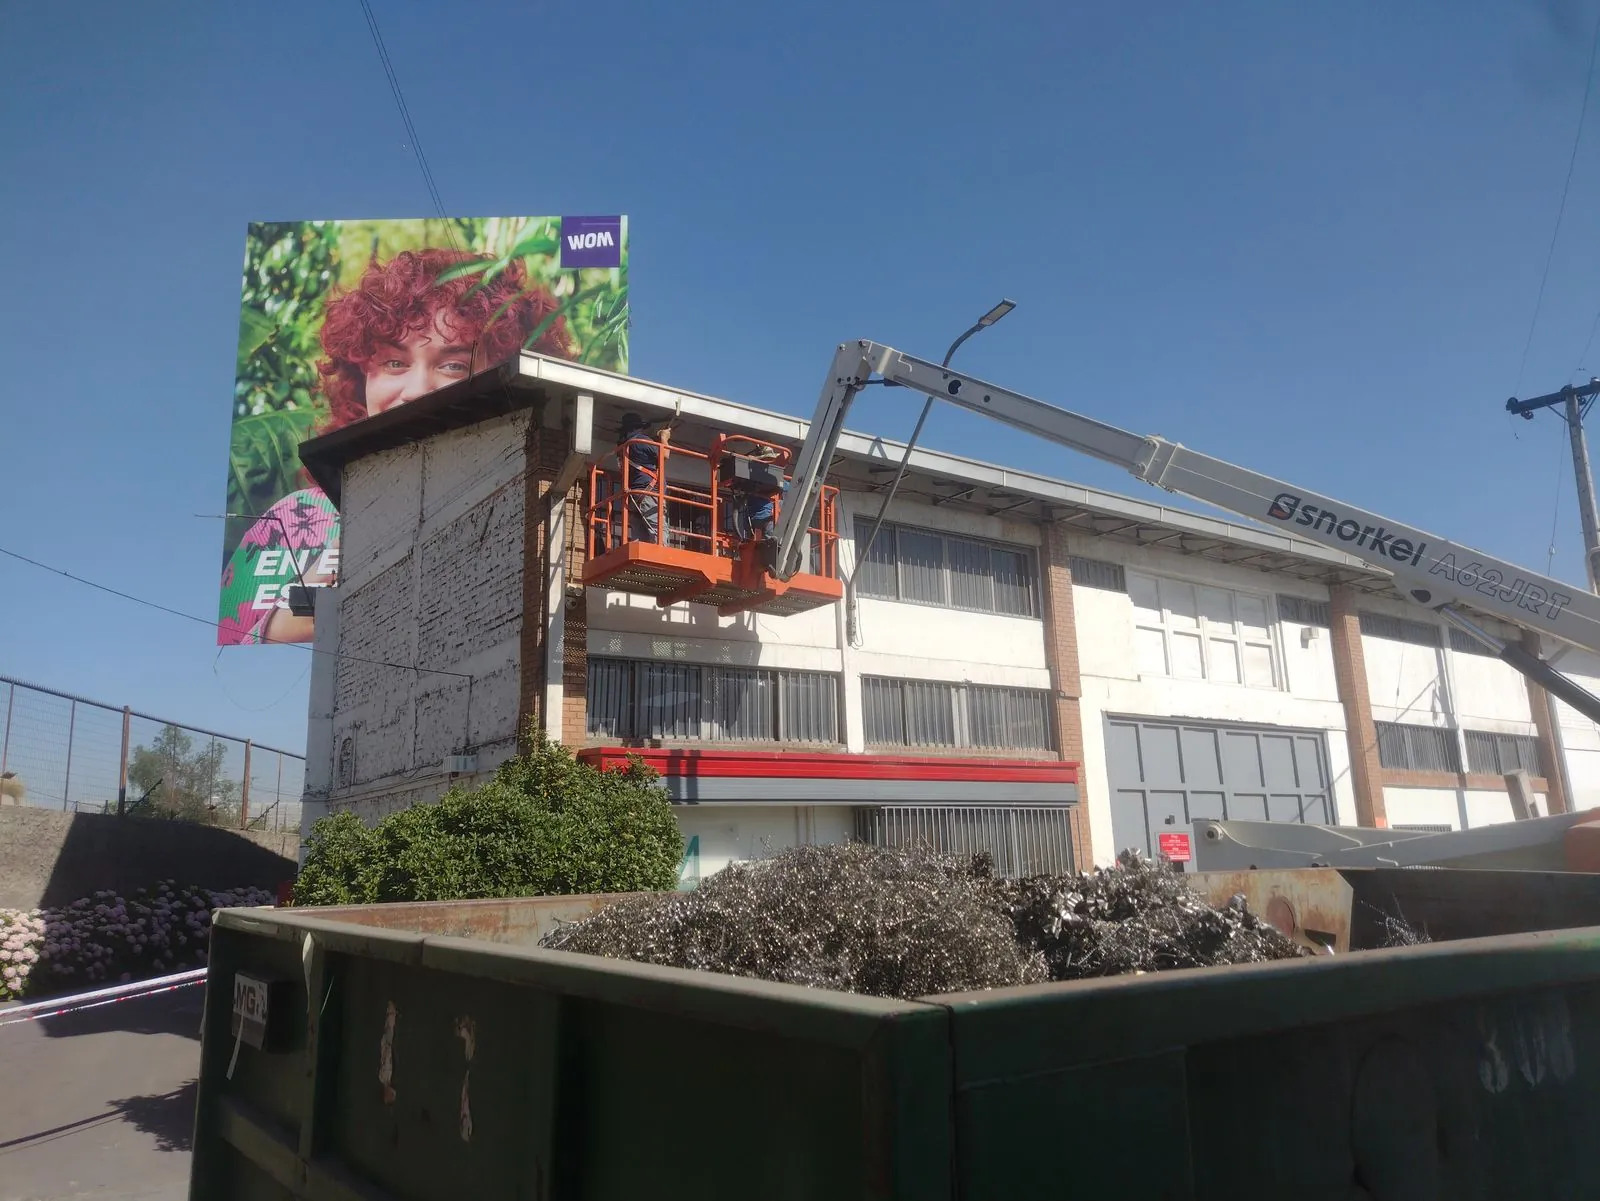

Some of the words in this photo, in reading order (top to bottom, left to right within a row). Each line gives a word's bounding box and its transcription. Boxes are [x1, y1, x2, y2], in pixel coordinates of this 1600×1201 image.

[567, 231, 614, 250] WOM
[254, 549, 310, 576] EN
[316, 548, 339, 575] E
[1295, 503, 1427, 566] snorkel
[1429, 552, 1571, 620] A62JRT
